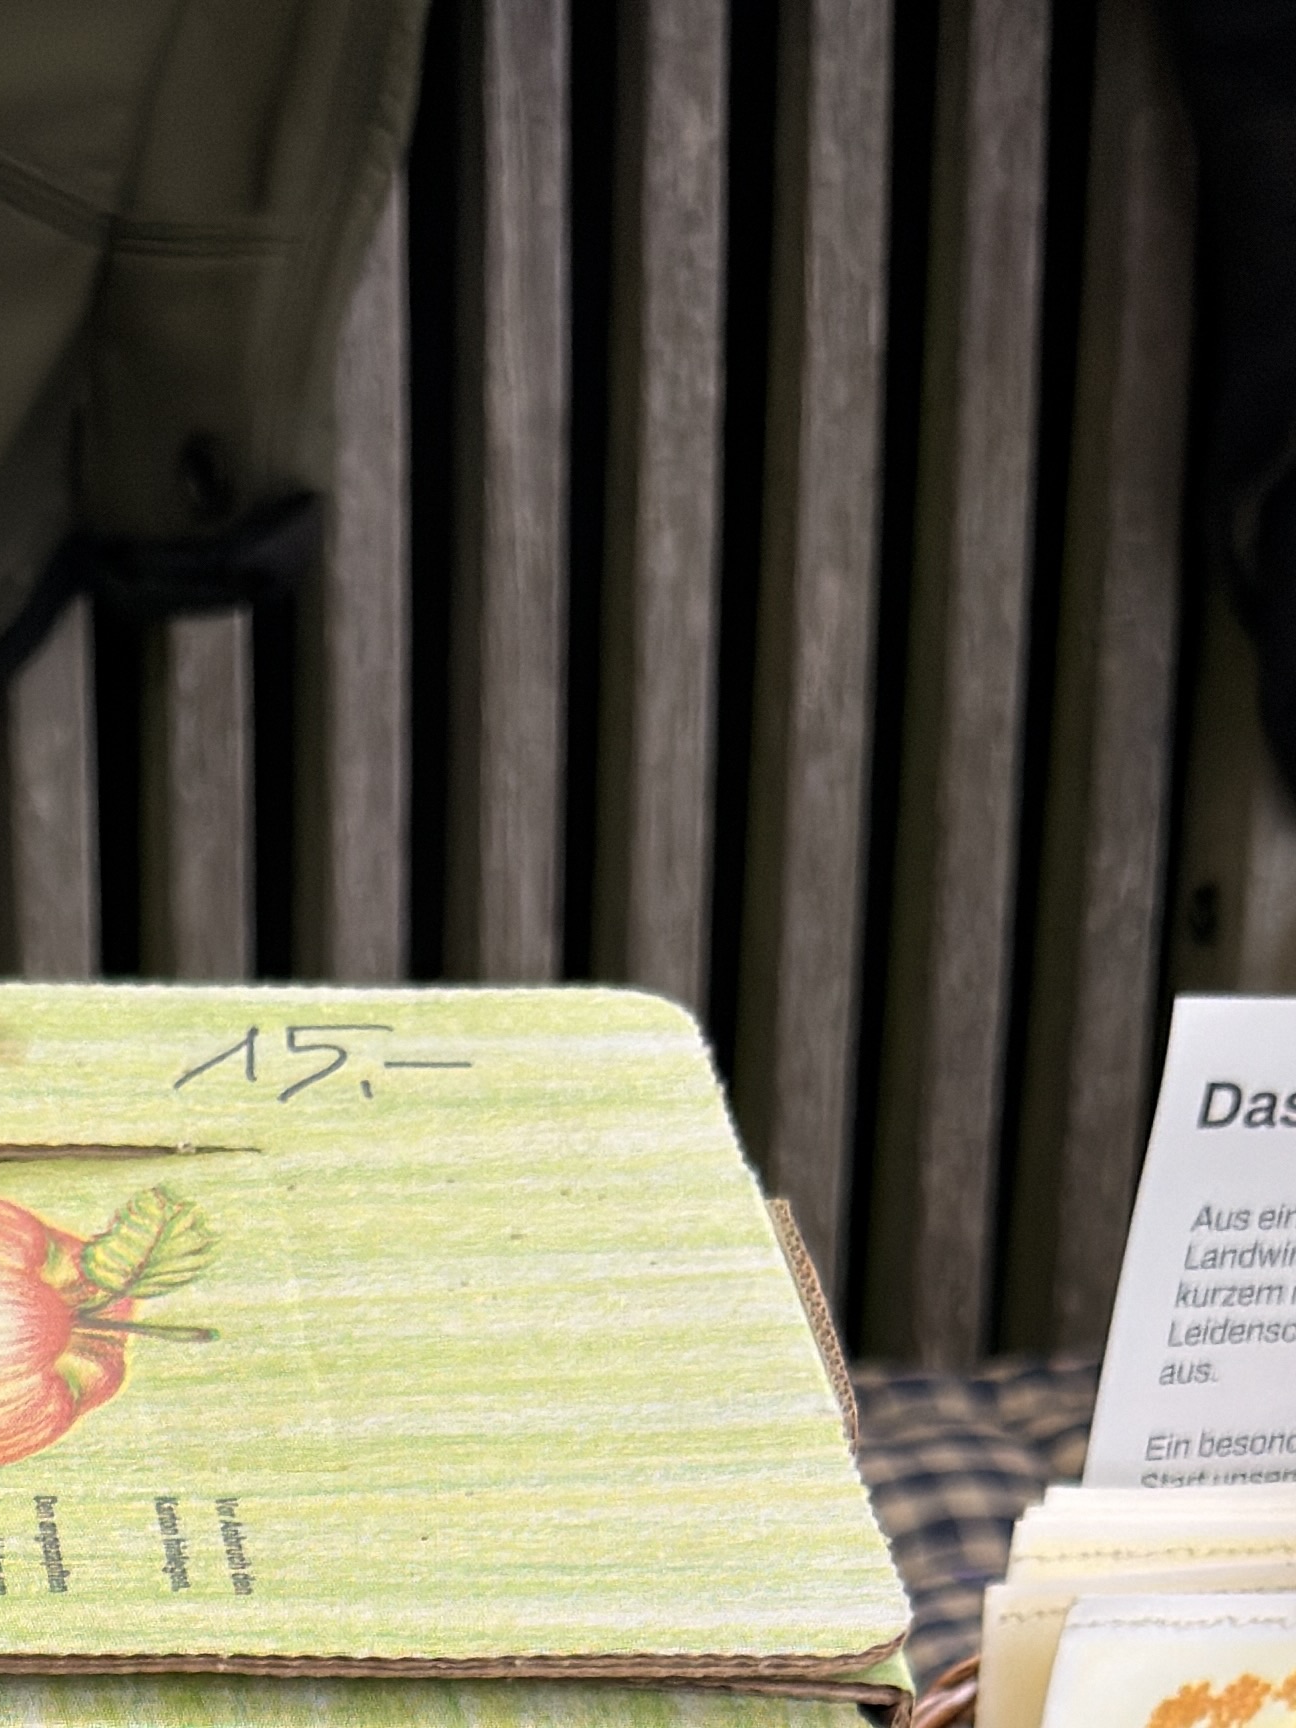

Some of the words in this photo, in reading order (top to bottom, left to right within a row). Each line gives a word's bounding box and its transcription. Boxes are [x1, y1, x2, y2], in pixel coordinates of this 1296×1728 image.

[1190, 1205, 1250, 1231] Aus
[1175, 1280, 1283, 1308] kurzem
[1145, 1434, 1191, 1461] Ein
[33, 1495, 57, 1518] Den
[155, 1496, 179, 1535] Karton
[215, 1497, 239, 1516] Vor
[34, 1521, 71, 1593] angezapften
[220, 1520, 253, 1569] Anbruch
[162, 1538, 190, 1592] hinlegen.
[231, 1573, 256, 1595] den
